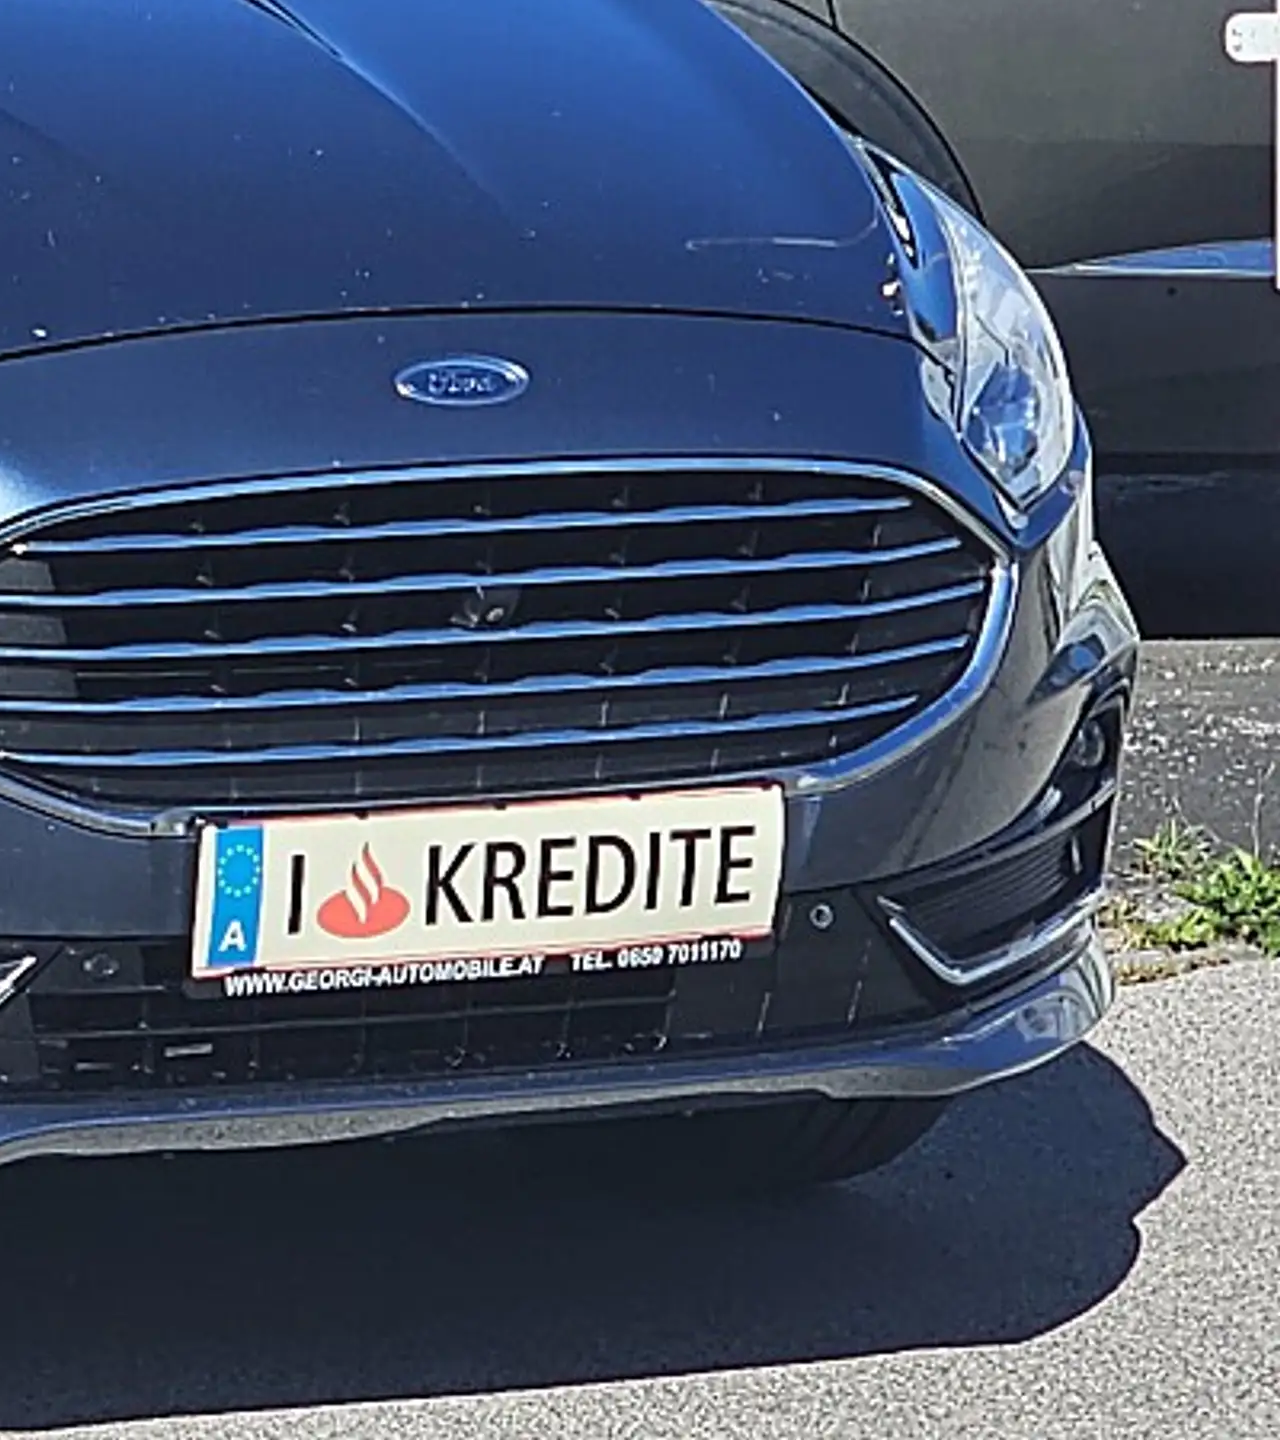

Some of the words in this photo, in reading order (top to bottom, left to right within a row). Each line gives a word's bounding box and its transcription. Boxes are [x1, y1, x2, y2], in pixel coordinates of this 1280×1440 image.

[287, 854, 306, 935] I
[424, 824, 756, 927] KREDITE
[218, 922, 246, 953] A
[224, 954, 545, 999] WWW.GEORGI-AUTOMOBILE.AT
[570, 950, 613, 973] TEL.
